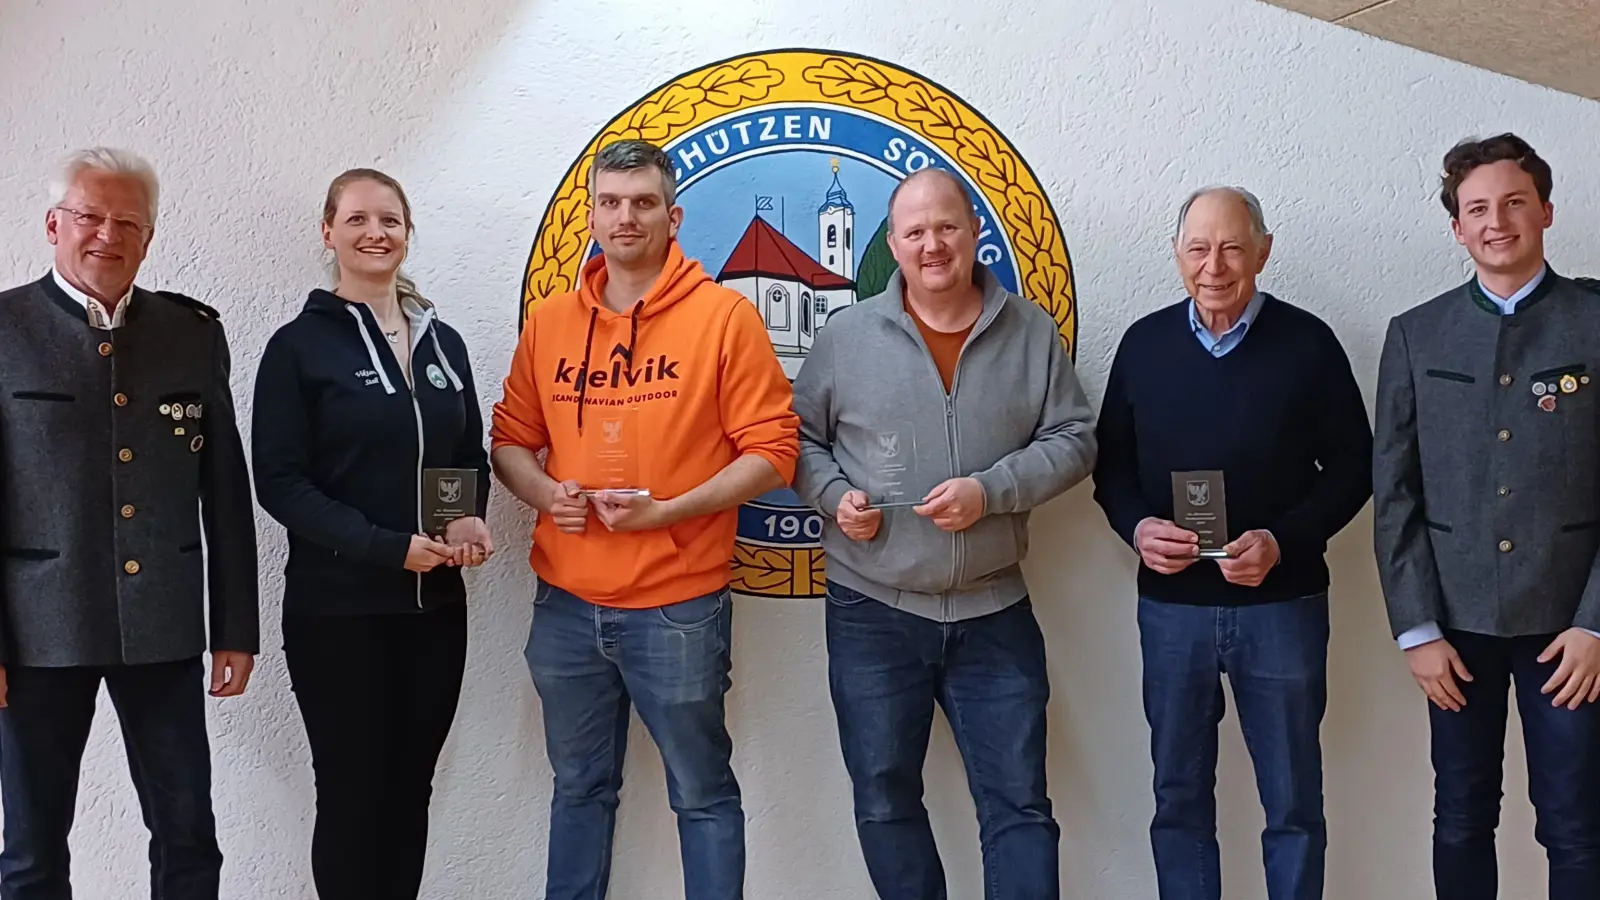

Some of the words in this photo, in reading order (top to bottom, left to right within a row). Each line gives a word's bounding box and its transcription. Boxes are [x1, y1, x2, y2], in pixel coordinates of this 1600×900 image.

[672, 115, 831, 181] HÜTZEN
[554, 354, 680, 392] kjelvik
[627, 390, 678, 404] OUTDOOR
[764, 514, 824, 539] 190
